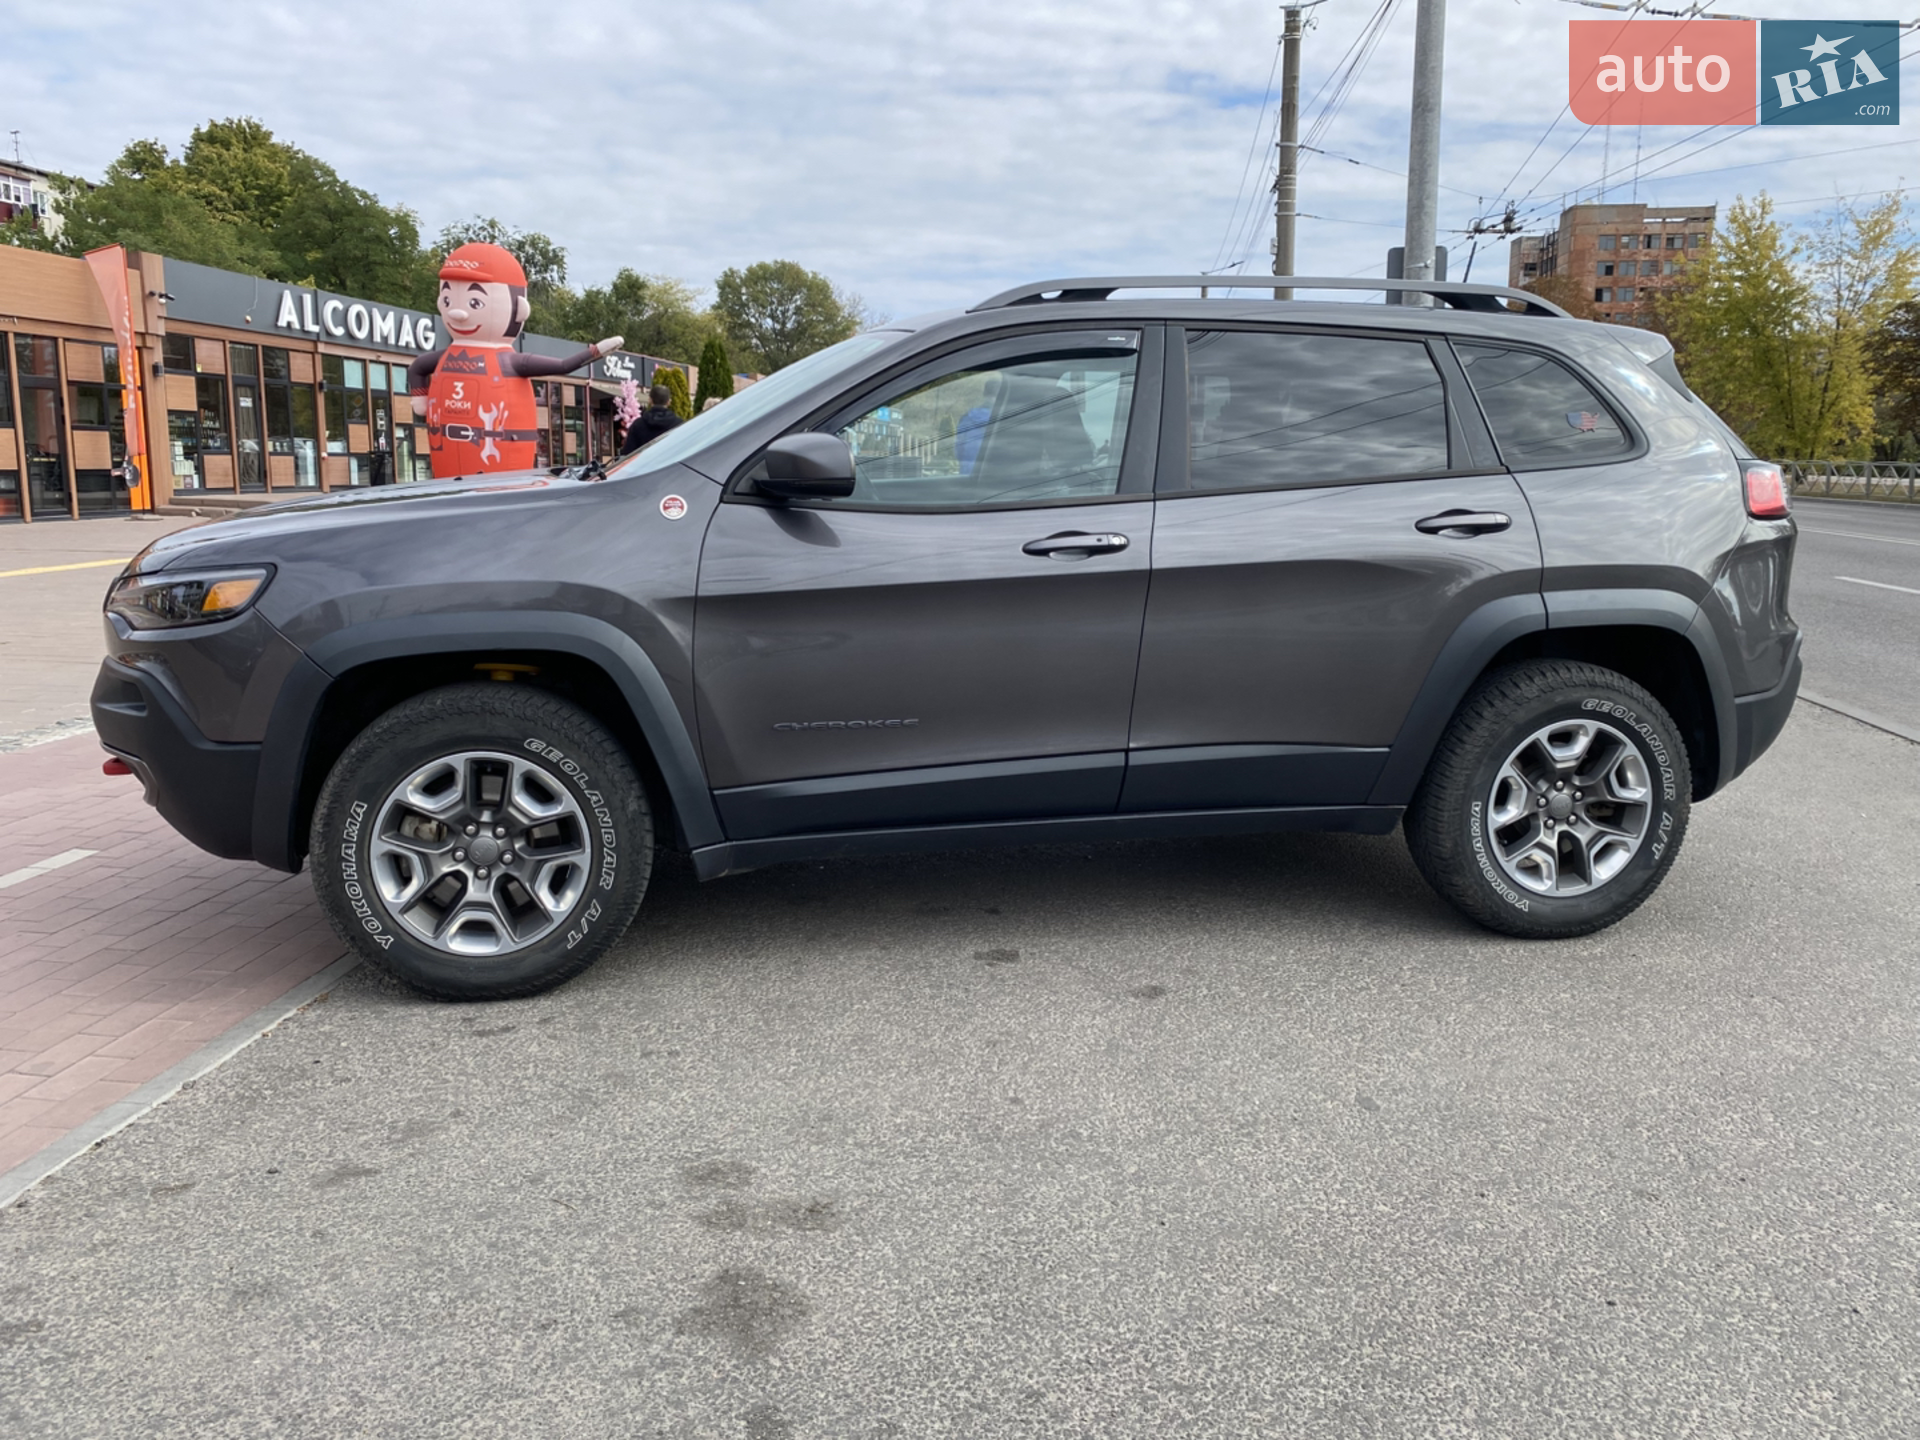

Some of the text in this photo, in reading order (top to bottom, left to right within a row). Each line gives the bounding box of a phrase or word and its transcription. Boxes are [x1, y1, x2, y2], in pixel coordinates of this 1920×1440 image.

[276, 289, 436, 350] ALCOMAG
[444, 399, 472, 410] РОКИ
[451, 381, 465, 400] 3
[772, 718, 920, 731] CHEROKEE
[1470, 698, 1676, 913] YOKOHAMA GEOLANDAR A/T
[339, 737, 617, 950] YOKOHAMA GEOLANDAR A/T
